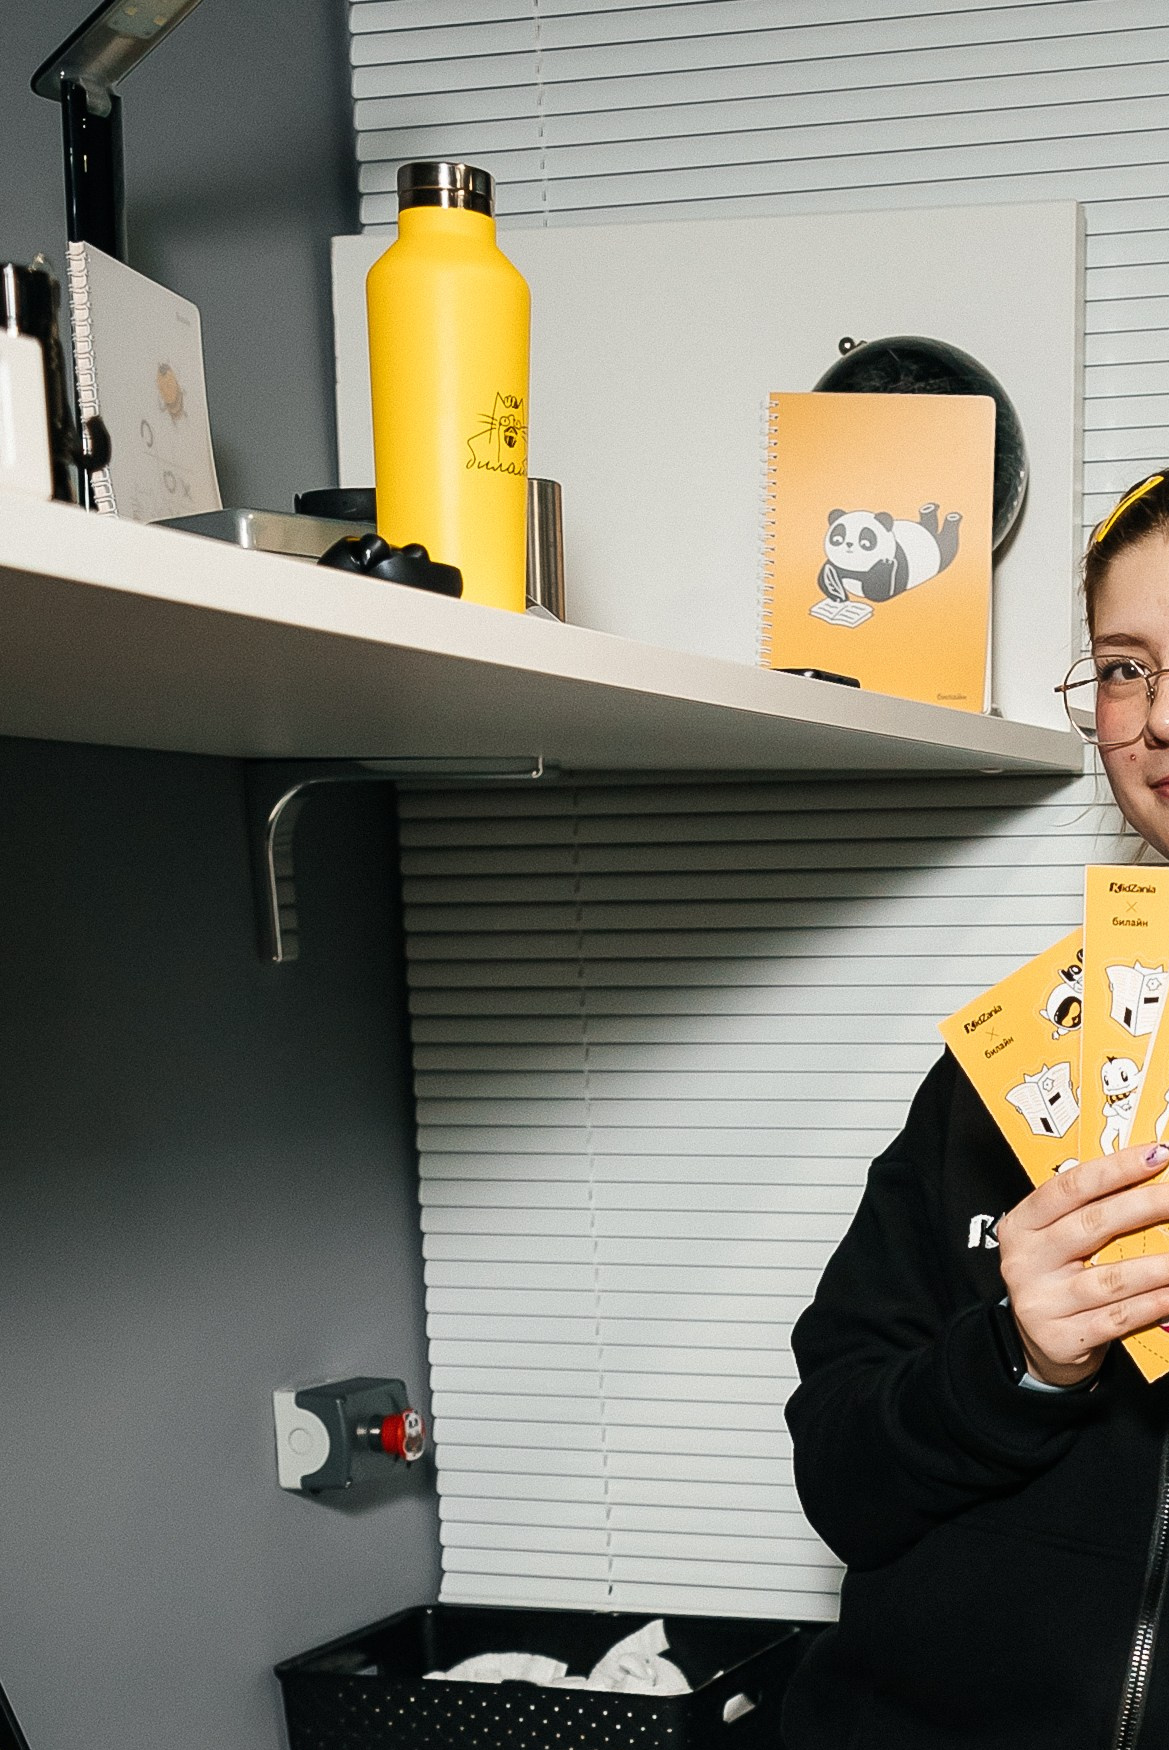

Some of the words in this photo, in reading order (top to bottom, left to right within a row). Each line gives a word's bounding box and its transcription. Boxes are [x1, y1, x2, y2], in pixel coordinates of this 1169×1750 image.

[1109, 882, 1156, 894] KidZania
[1112, 916, 1149, 928] билайн
[963, 1004, 1003, 1035] KidZania
[984, 1036, 1015, 1059] билайн
